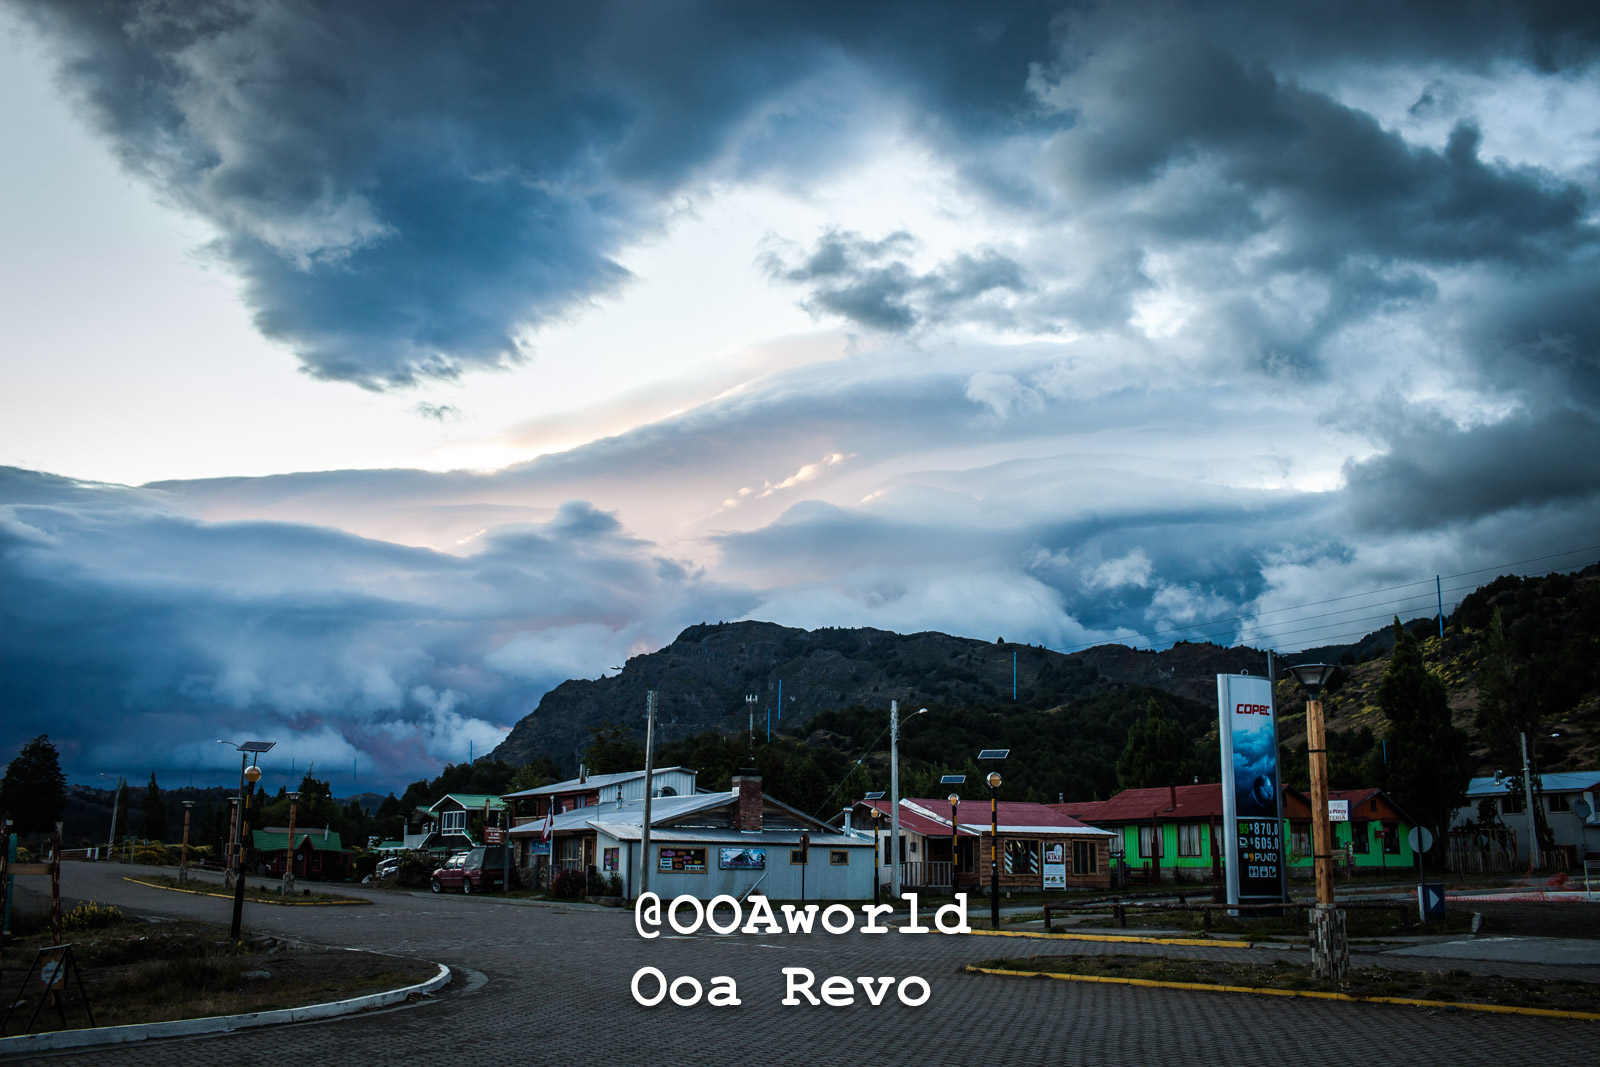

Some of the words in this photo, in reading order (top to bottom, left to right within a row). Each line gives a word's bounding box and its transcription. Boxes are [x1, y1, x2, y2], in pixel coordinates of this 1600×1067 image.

[1236, 703, 1270, 716] COPEC
[1238, 822, 1249, 835] 95
[1254, 852, 1278, 863] PUNTO
